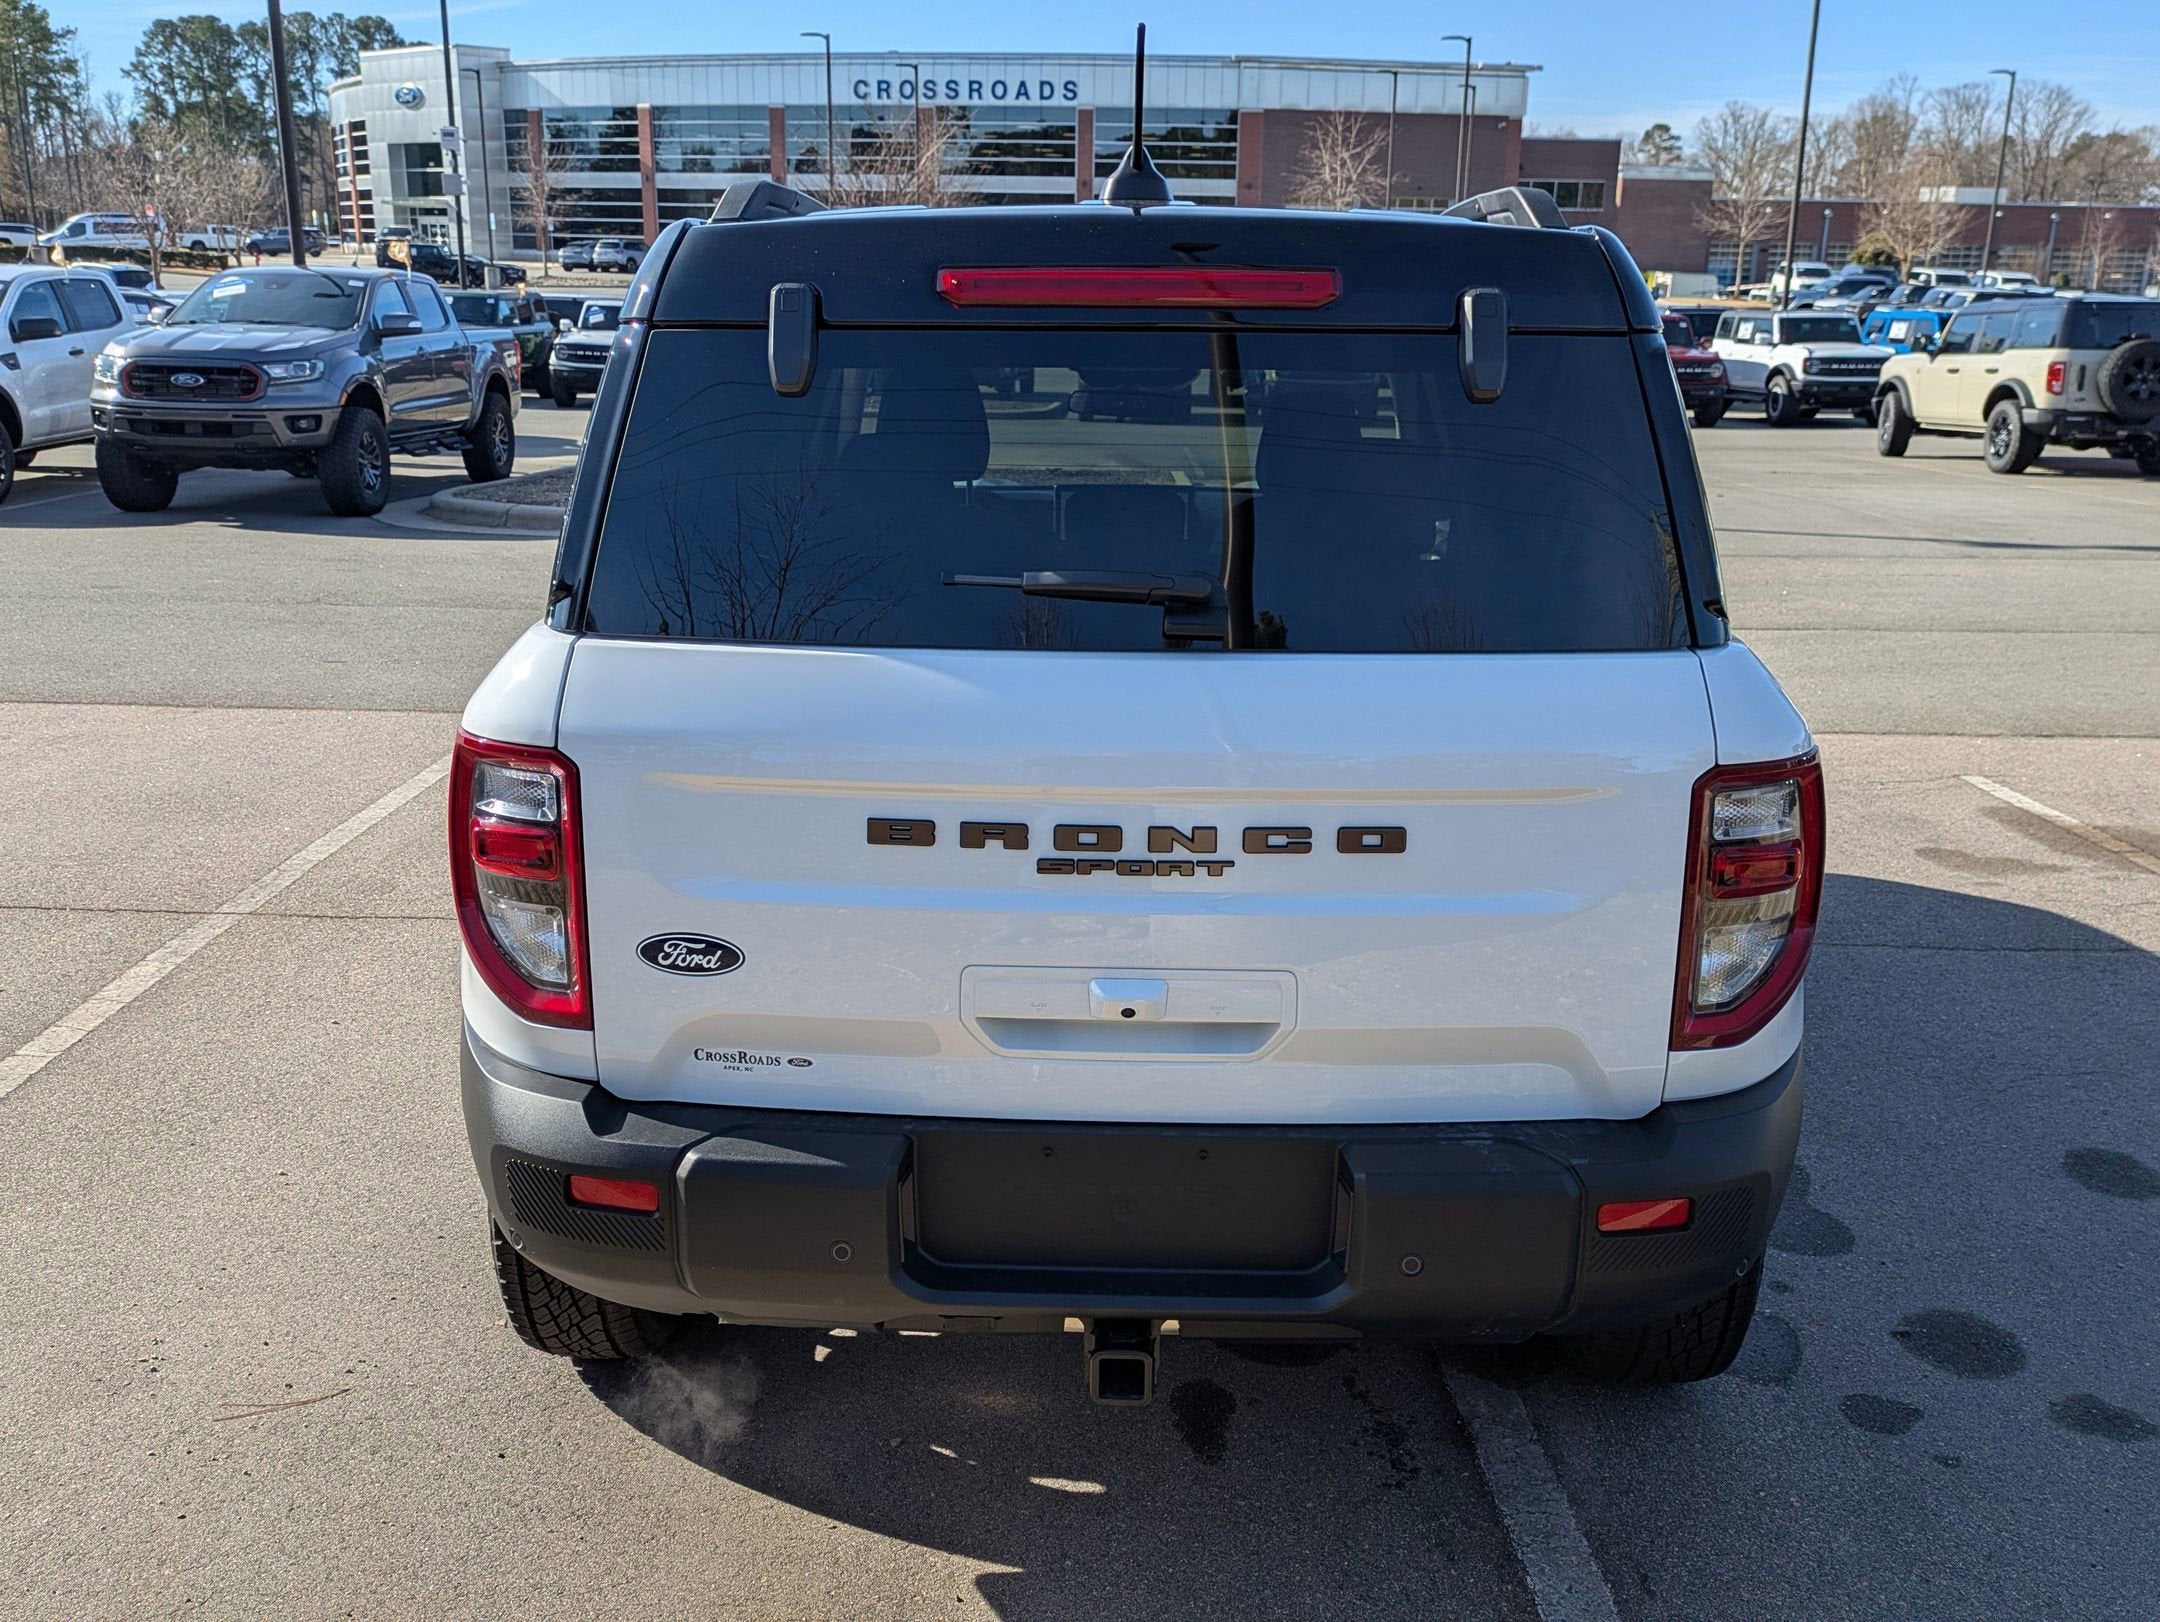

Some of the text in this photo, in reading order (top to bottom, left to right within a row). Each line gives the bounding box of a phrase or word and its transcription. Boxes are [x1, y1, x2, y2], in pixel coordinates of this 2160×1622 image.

[853, 79, 1078, 101] CROSSROADS
[866, 817, 1407, 855] BRONCO
[1036, 858, 1236, 877] SPORT
[657, 940, 723, 969] Ford
